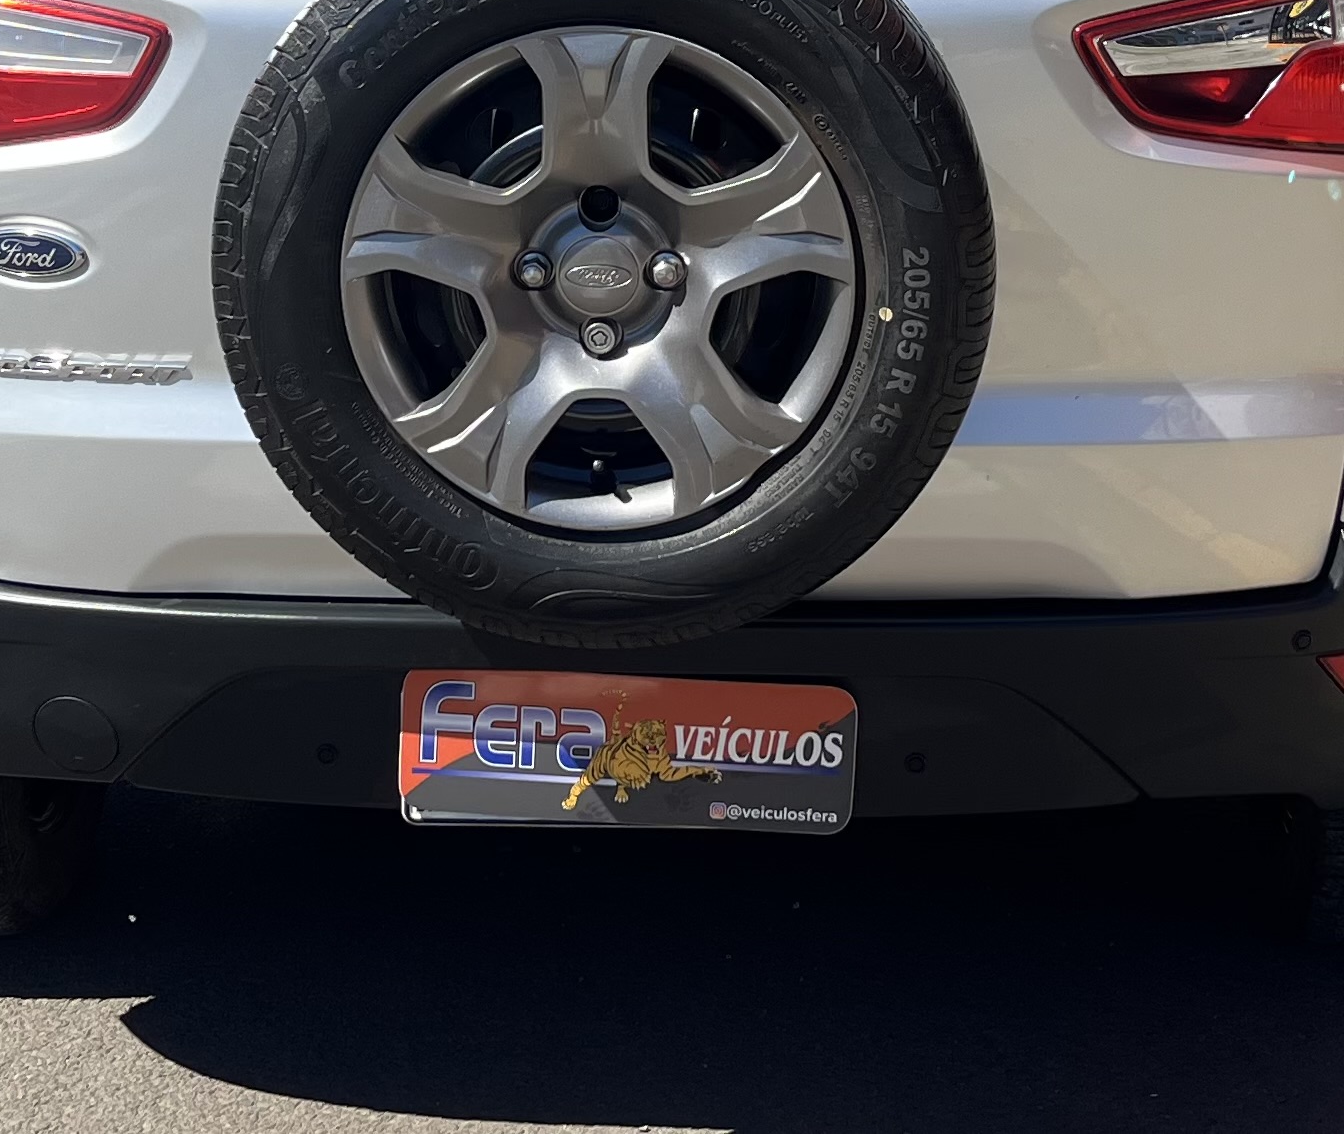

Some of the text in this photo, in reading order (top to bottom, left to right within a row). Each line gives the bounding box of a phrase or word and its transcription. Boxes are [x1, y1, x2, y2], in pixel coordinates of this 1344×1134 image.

[817, 246, 934, 509] 205/65 R 15 94T
[673, 715, 845, 768] VEÍCULOS
[726, 804, 838, 823] @veiculosfera
